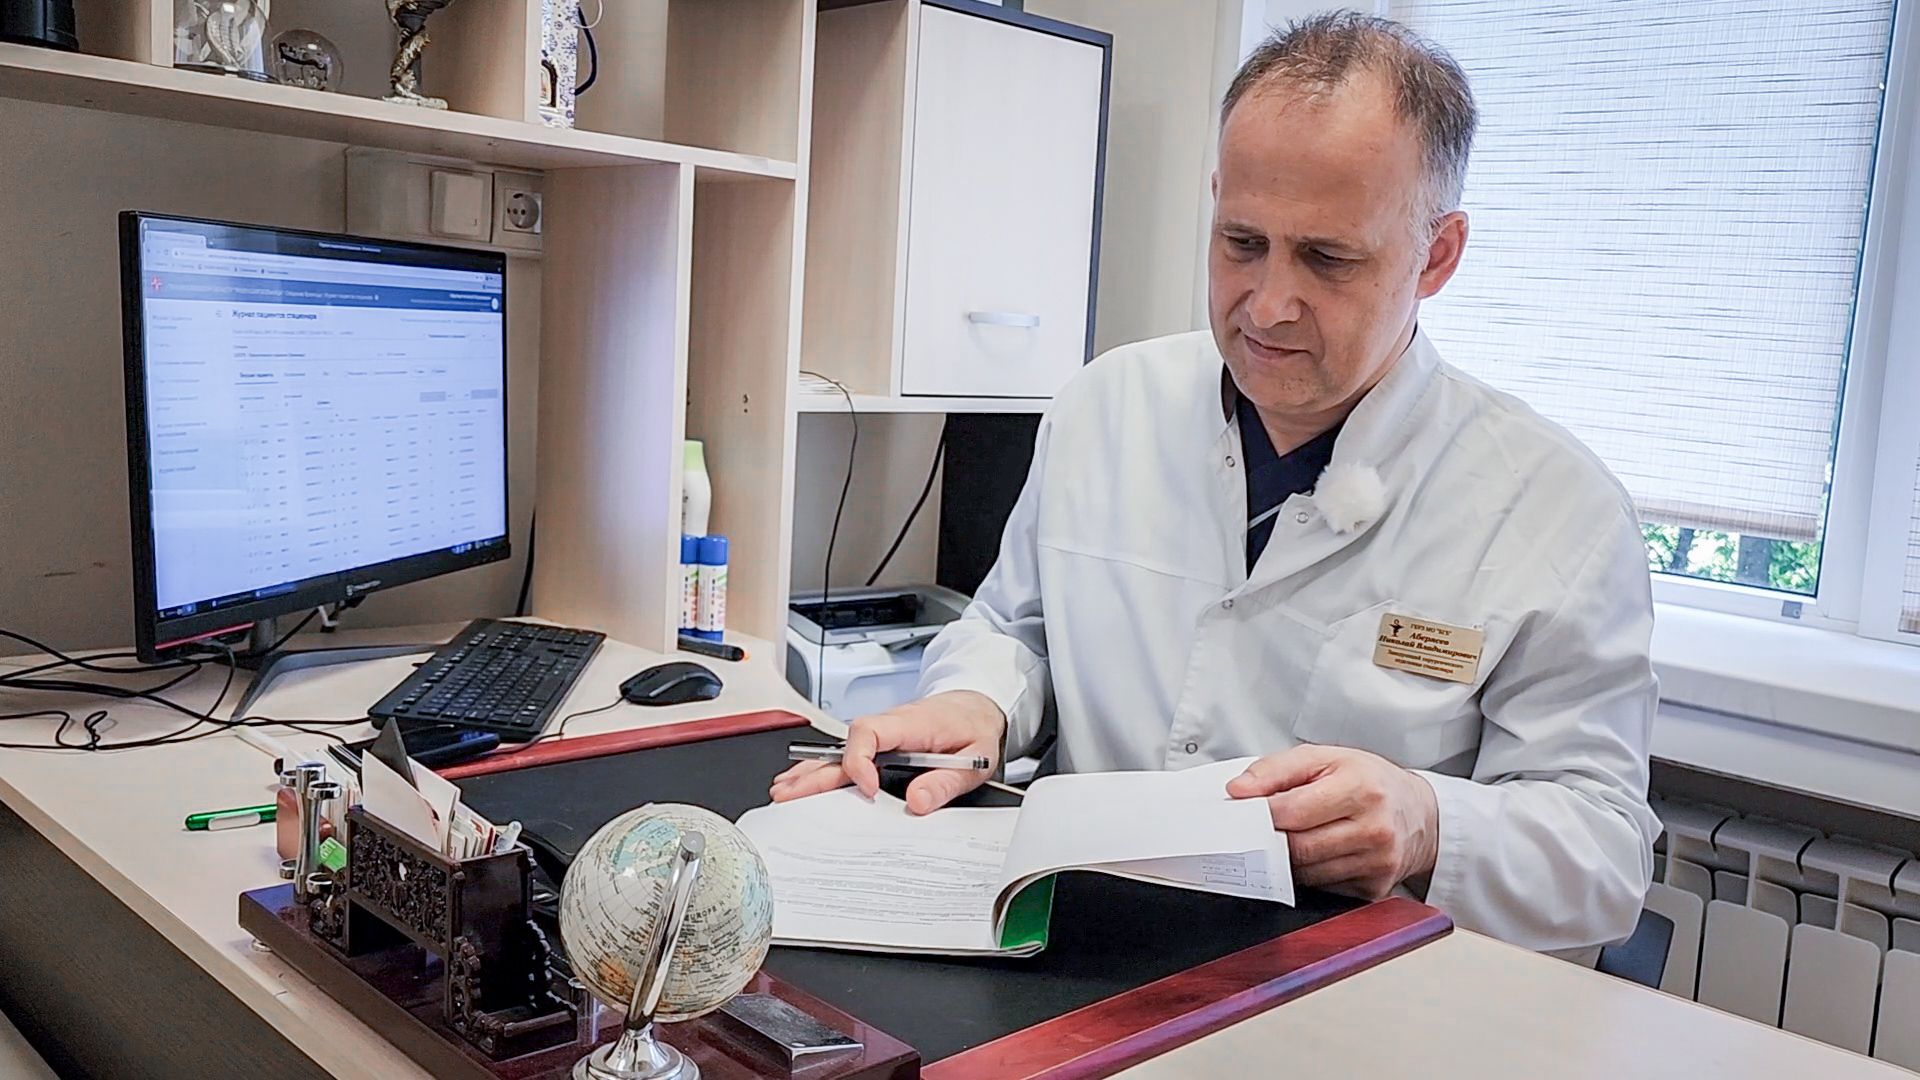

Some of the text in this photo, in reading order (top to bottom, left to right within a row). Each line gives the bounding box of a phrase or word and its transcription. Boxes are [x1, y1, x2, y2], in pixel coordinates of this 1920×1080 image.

[232, 310, 255, 318] Журнал
[1378, 635, 1478, 660] Николай Владимирович
[684, 905, 717, 922] EUROPE
